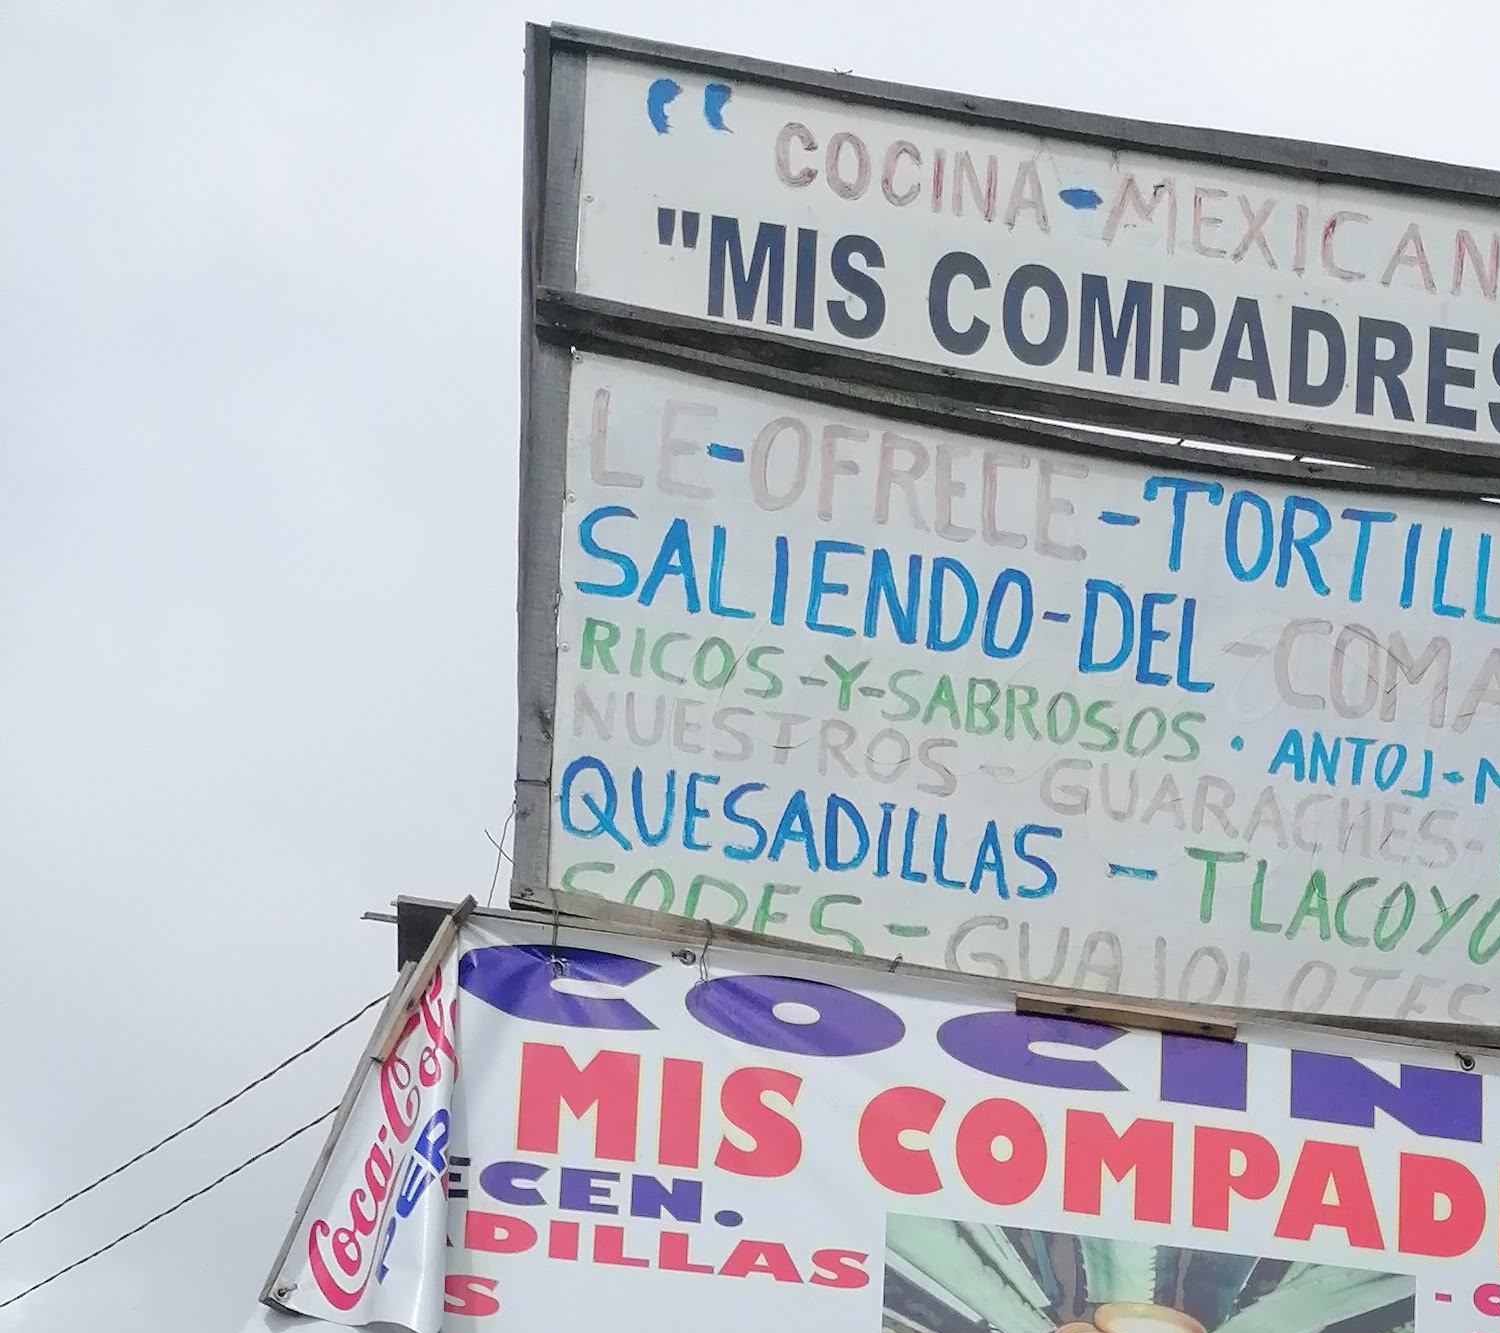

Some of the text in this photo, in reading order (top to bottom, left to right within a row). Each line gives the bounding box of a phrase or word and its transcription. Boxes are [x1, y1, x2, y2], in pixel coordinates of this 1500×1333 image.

[571, 690, 959, 798] NUESTROS
[559, 754, 1063, 900] QUESADILLAS
[515, 1041, 803, 1179] MIS
[448, 1209, 871, 1291] DILLAS
